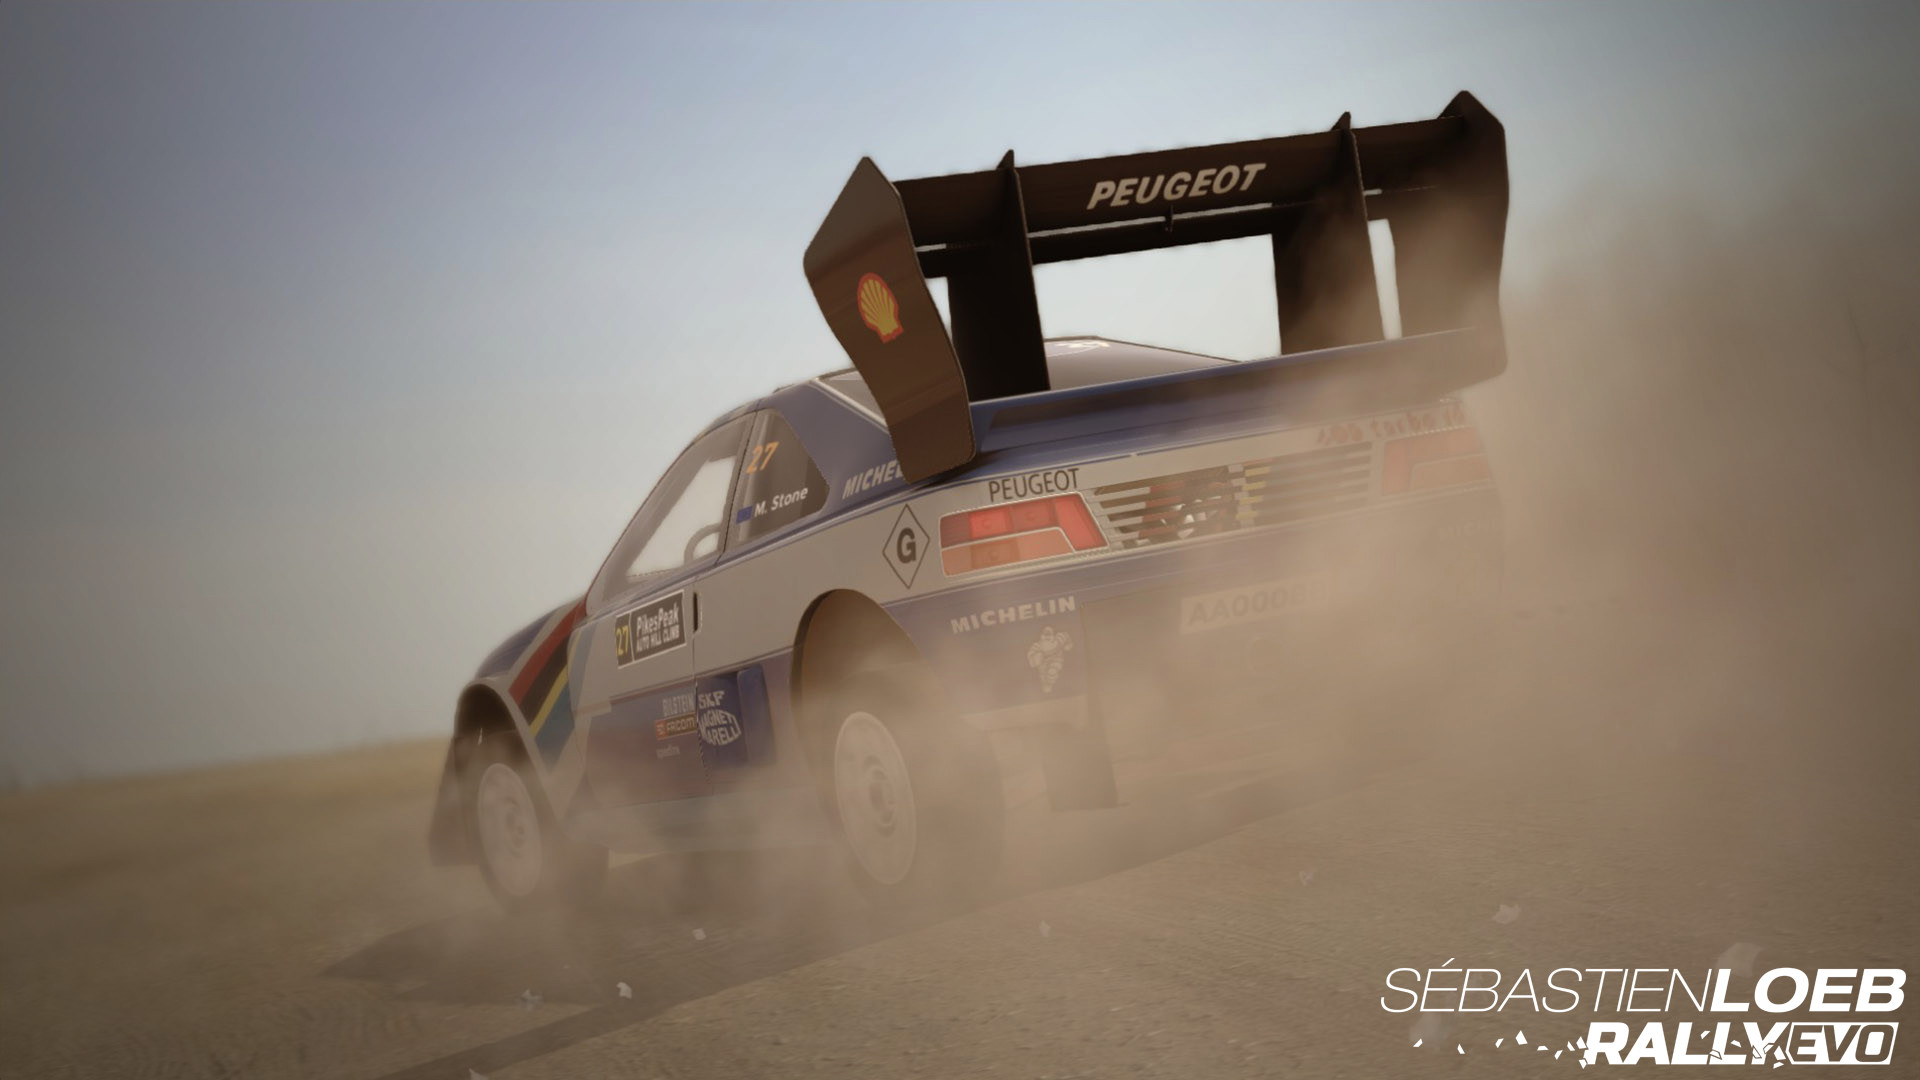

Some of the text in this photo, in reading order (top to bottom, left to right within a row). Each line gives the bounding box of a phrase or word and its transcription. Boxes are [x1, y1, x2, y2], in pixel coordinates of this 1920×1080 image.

[1086, 163, 1267, 210] PEUGEOT
[745, 441, 779, 475] 27
[754, 487, 808, 517] M. Stone
[988, 468, 1080, 503] PEUGEOT
[897, 527, 917, 564] G
[950, 596, 1076, 634] MICHELIN
[615, 625, 629, 656] 27
[698, 690, 725, 710] SKF
